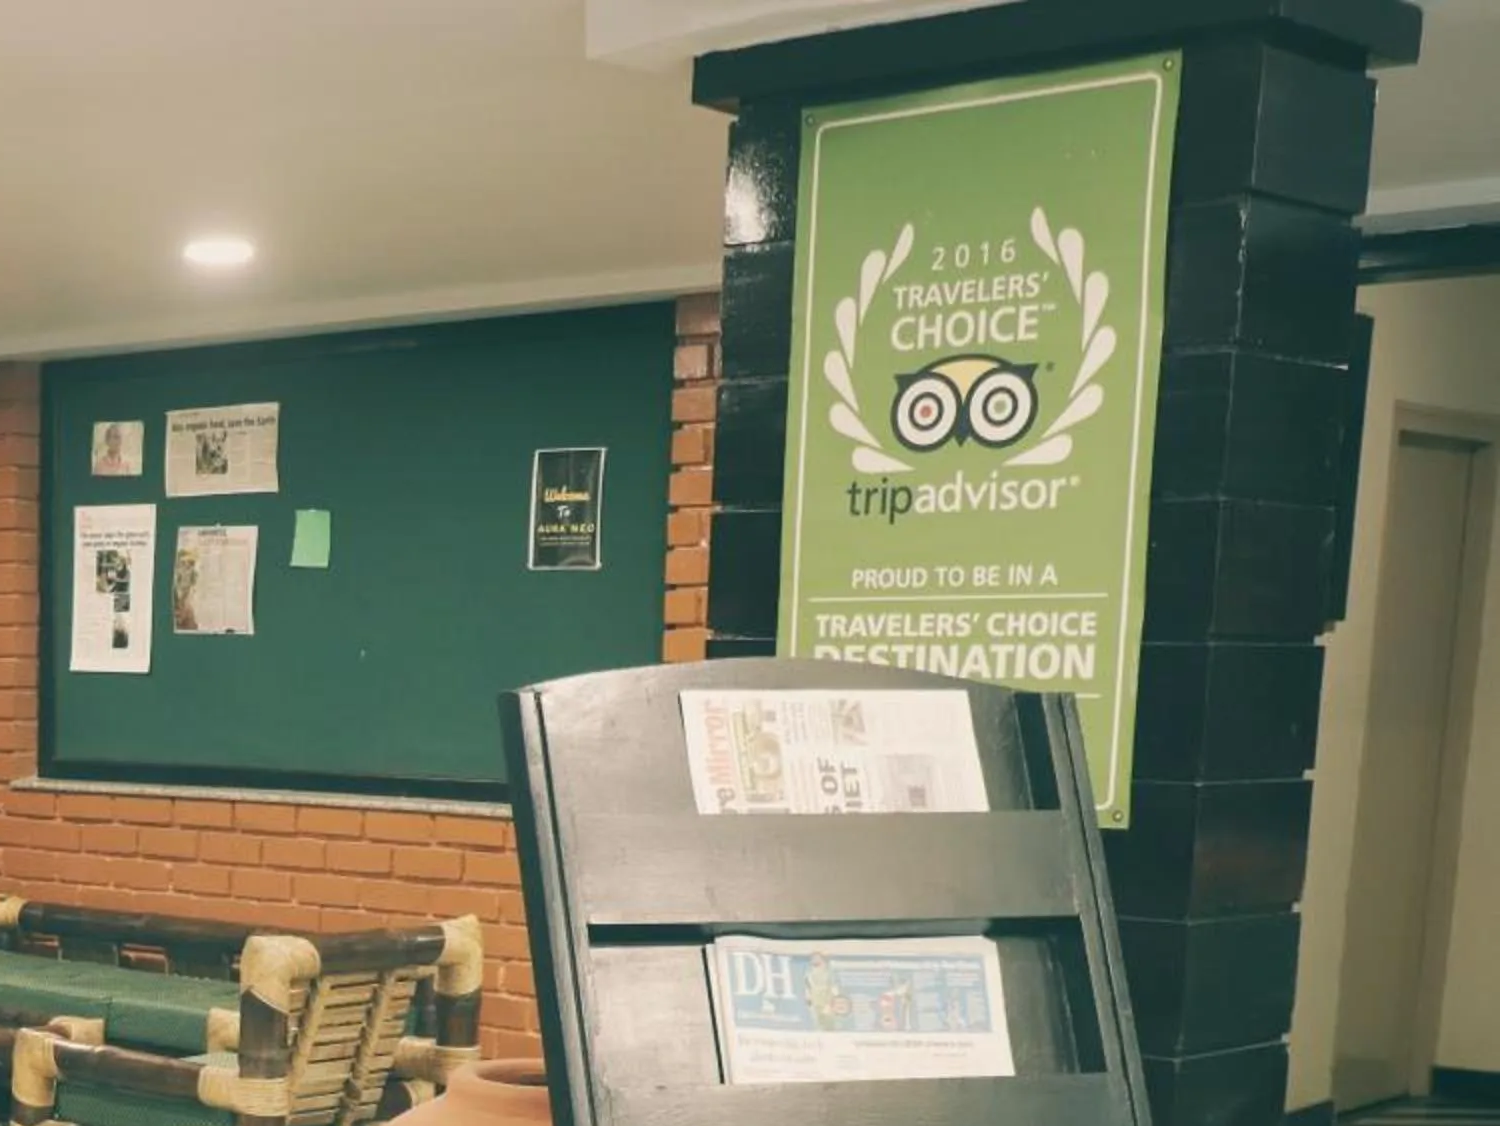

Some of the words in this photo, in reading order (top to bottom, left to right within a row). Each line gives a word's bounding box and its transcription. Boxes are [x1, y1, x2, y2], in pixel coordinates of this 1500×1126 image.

[931, 238, 1017, 272] 2016
[847, 470, 1068, 525] tripadvisor
[851, 566, 928, 590] PROUD
[934, 566, 965, 588] TO
[973, 565, 1001, 587] BE
[1008, 564, 1033, 586] IN
[1040, 563, 1058, 586] A
[986, 611, 1098, 637] CHOICE
[732, 951, 796, 999] DH
